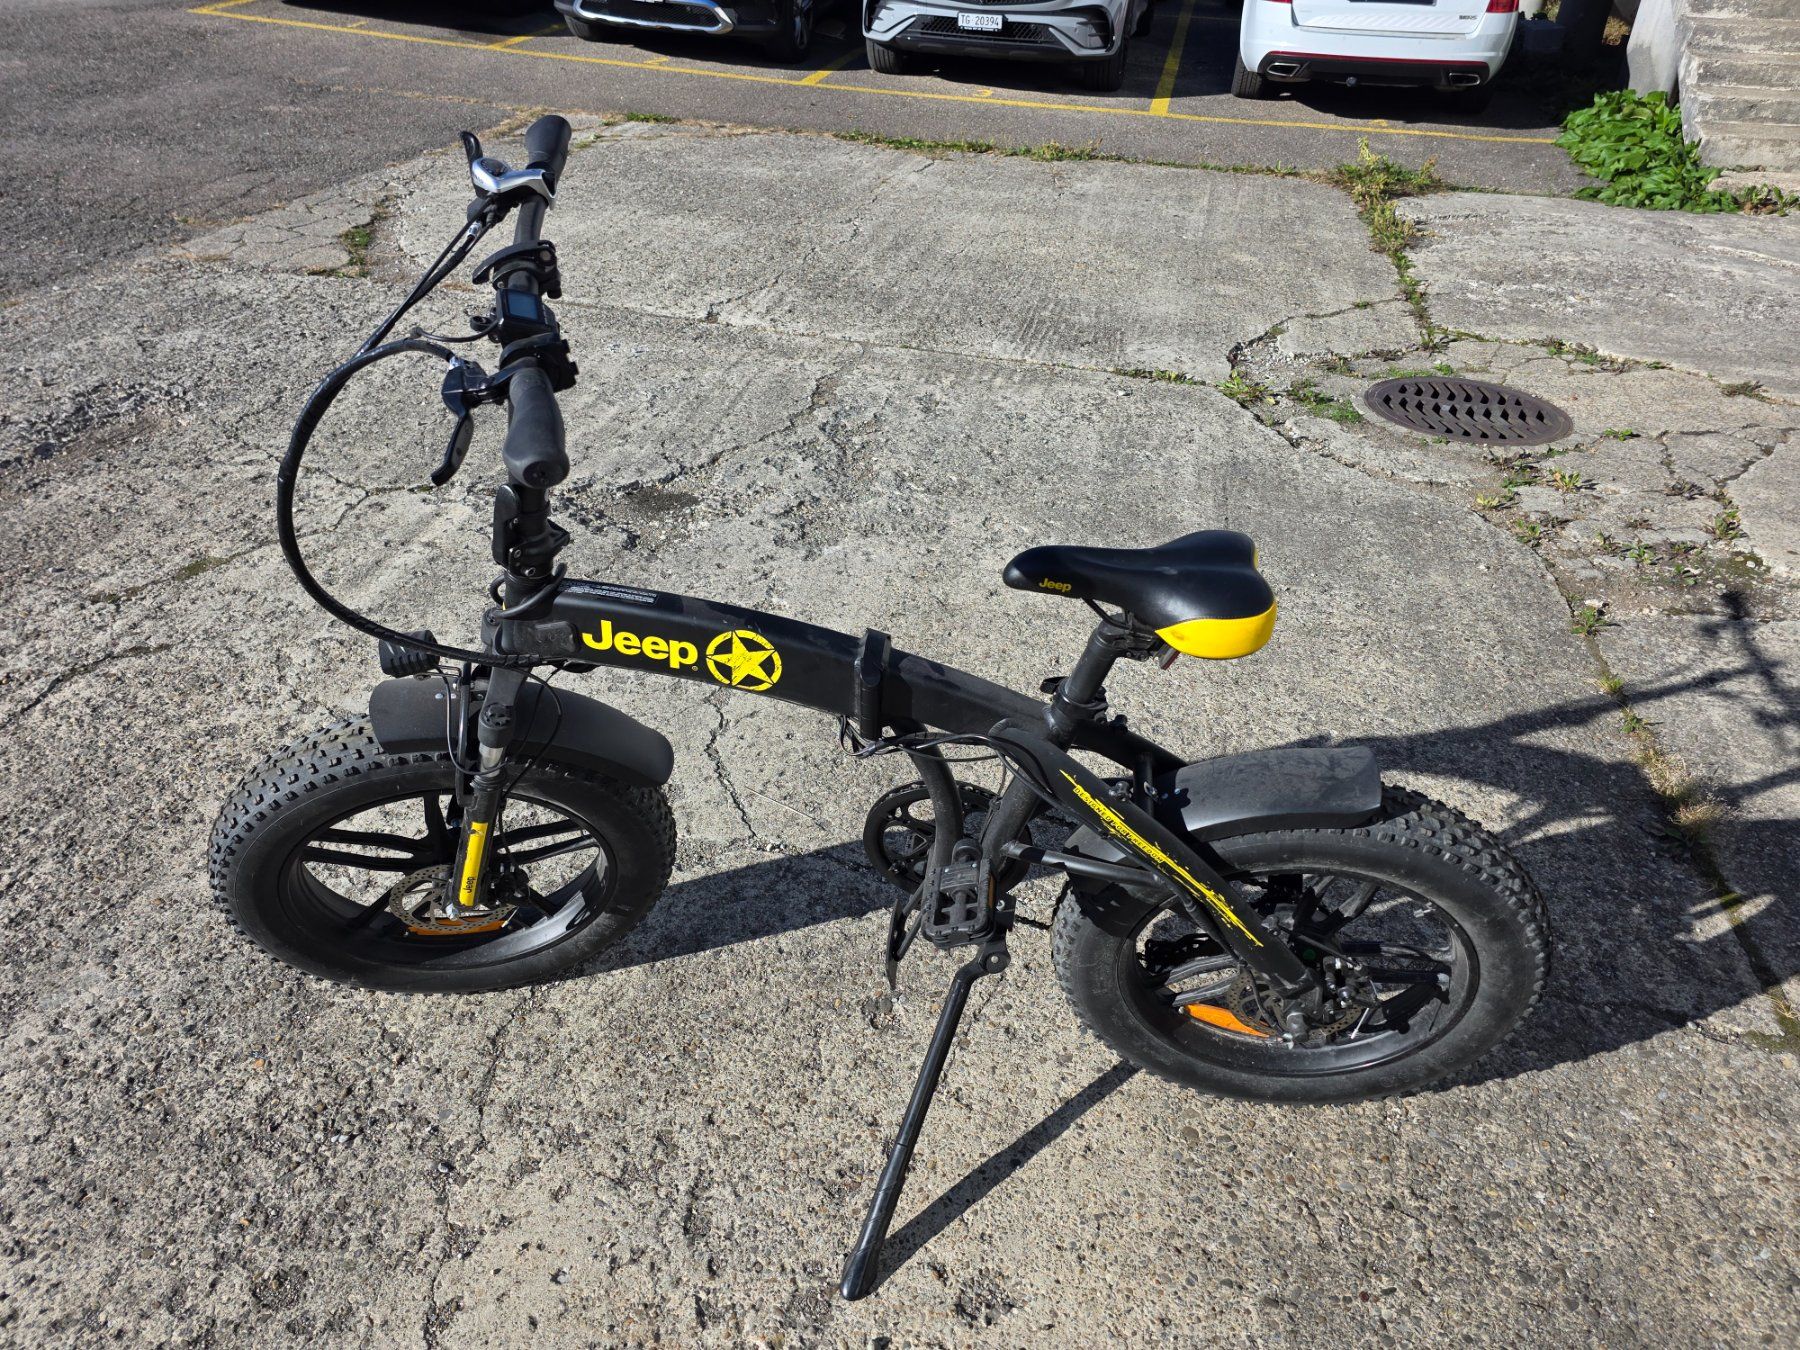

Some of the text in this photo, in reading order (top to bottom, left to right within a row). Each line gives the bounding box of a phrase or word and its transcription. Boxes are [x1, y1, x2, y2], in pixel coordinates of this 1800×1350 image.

[961, 15, 999, 26] TG 20394
[1039, 578, 1072, 593] Jeep
[582, 619, 699, 669] Jeep
[463, 876, 475, 894] Jeep
